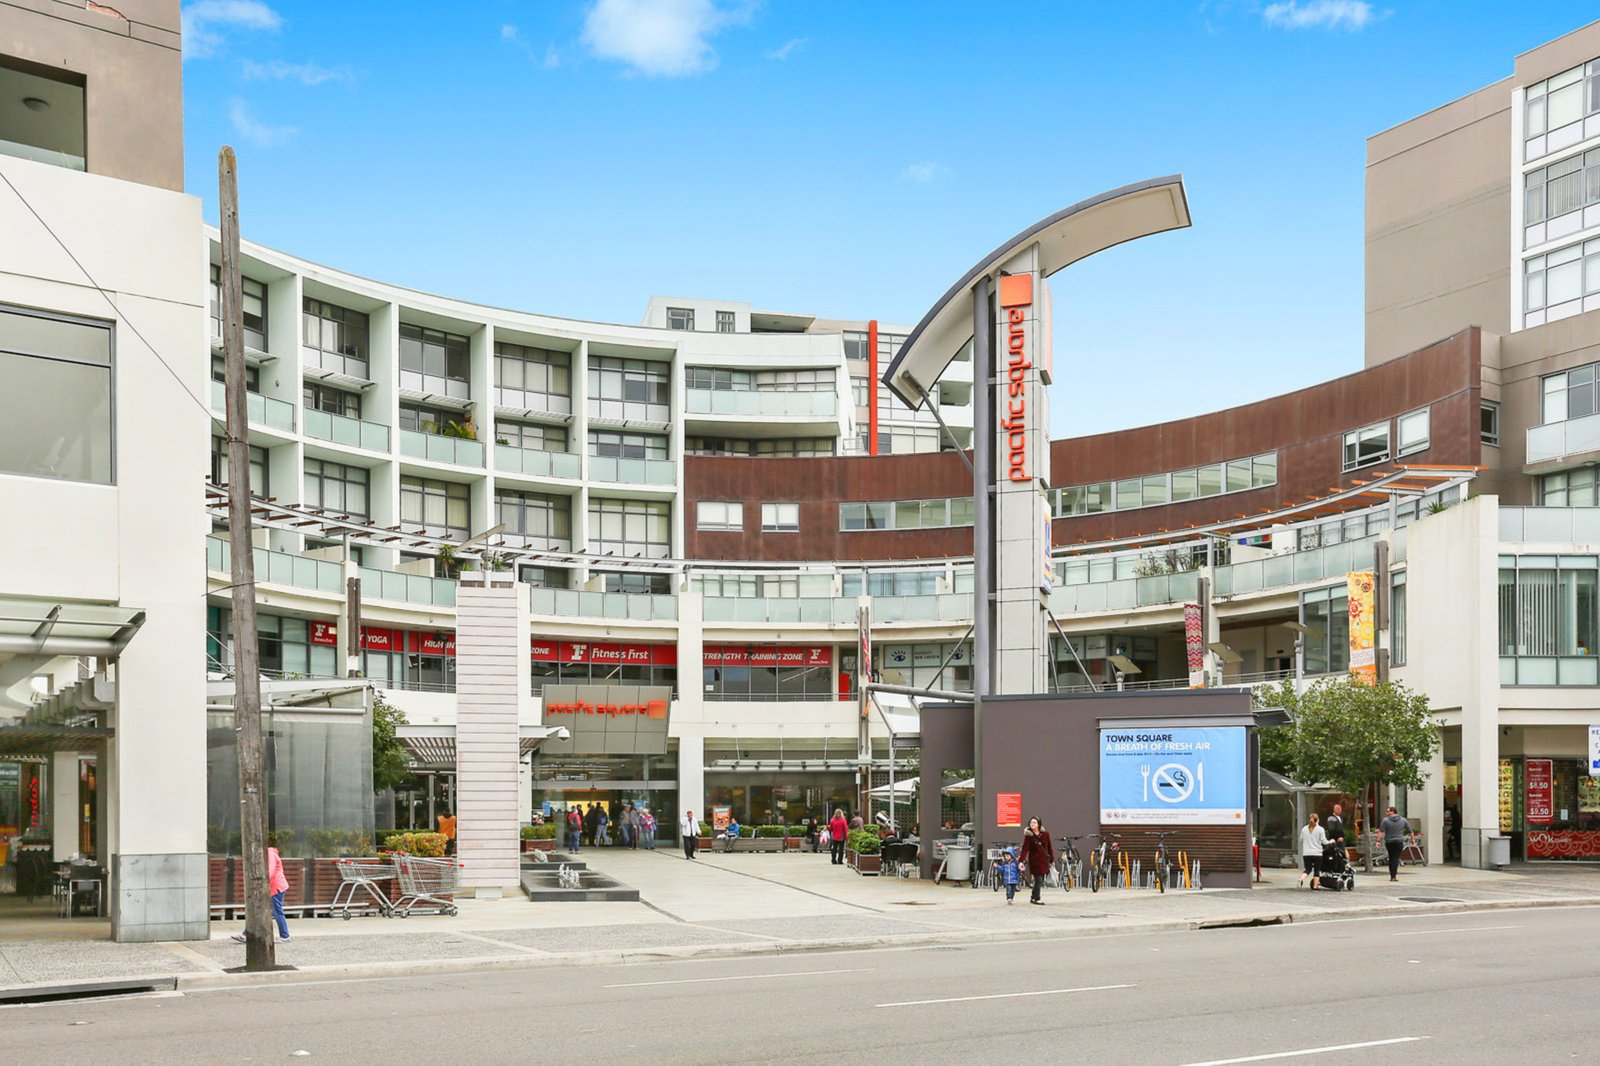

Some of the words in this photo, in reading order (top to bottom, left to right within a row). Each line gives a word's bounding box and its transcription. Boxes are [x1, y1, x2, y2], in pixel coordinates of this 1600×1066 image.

[1008, 307, 1032, 397] square
[1001, 399, 1032, 482] pacific
[367, 634, 388, 644] YOGA
[424, 639, 444, 649] HIGH
[703, 652, 741, 660] TRENGTH
[783, 652, 804, 661] ZONE
[1106, 734, 1134, 743] TOWN
[1136, 733, 1172, 743] SQUARE
[1105, 743, 1112, 752] A
[1114, 742, 1148, 751] BREATH
[1150, 742, 1162, 751] OF
[1165, 742, 1193, 751] FRESH
[1195, 741, 1211, 750] AIR
